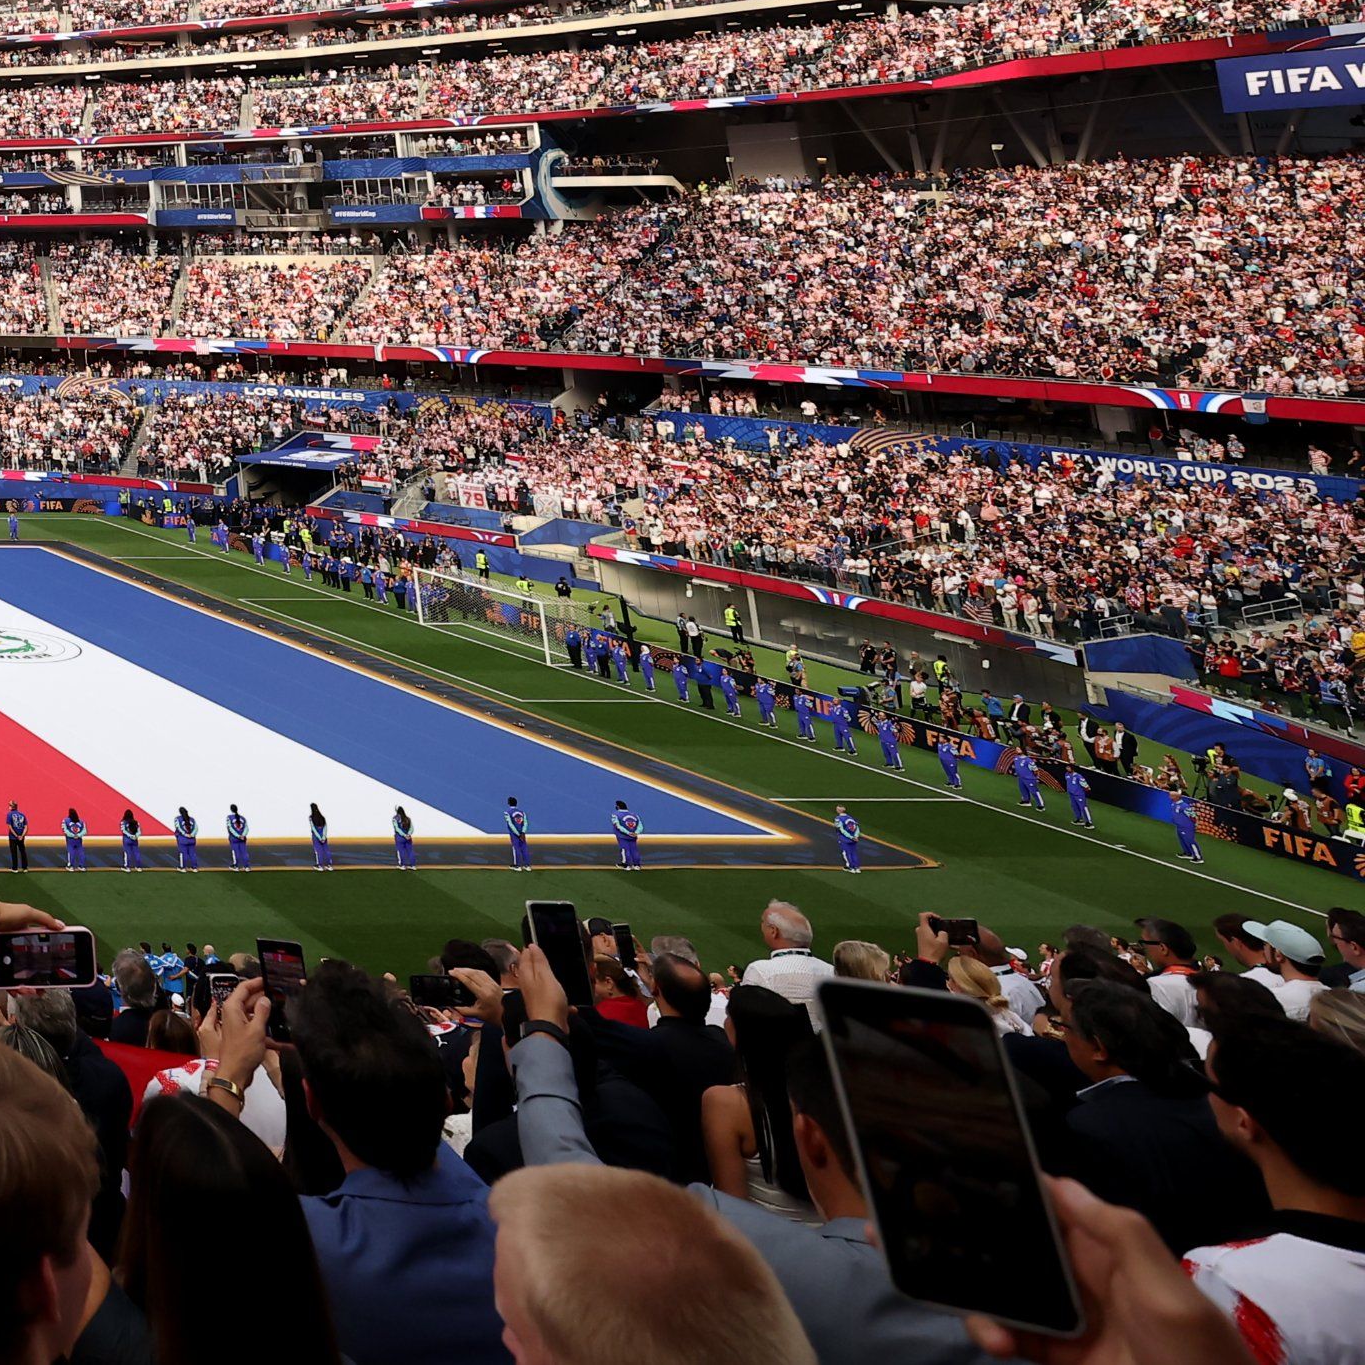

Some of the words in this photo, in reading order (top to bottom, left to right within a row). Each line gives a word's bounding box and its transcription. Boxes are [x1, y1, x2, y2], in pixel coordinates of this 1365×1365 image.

[1245, 66, 1343, 96] FIFA
[244, 387, 278, 397] LOS
[283, 389, 365, 401] ANGELES
[1181, 466, 1227, 482] CUP
[39, 501, 63, 510] FIFA
[164, 516, 187, 526] FIFA
[1262, 826, 1337, 867] FIFA
